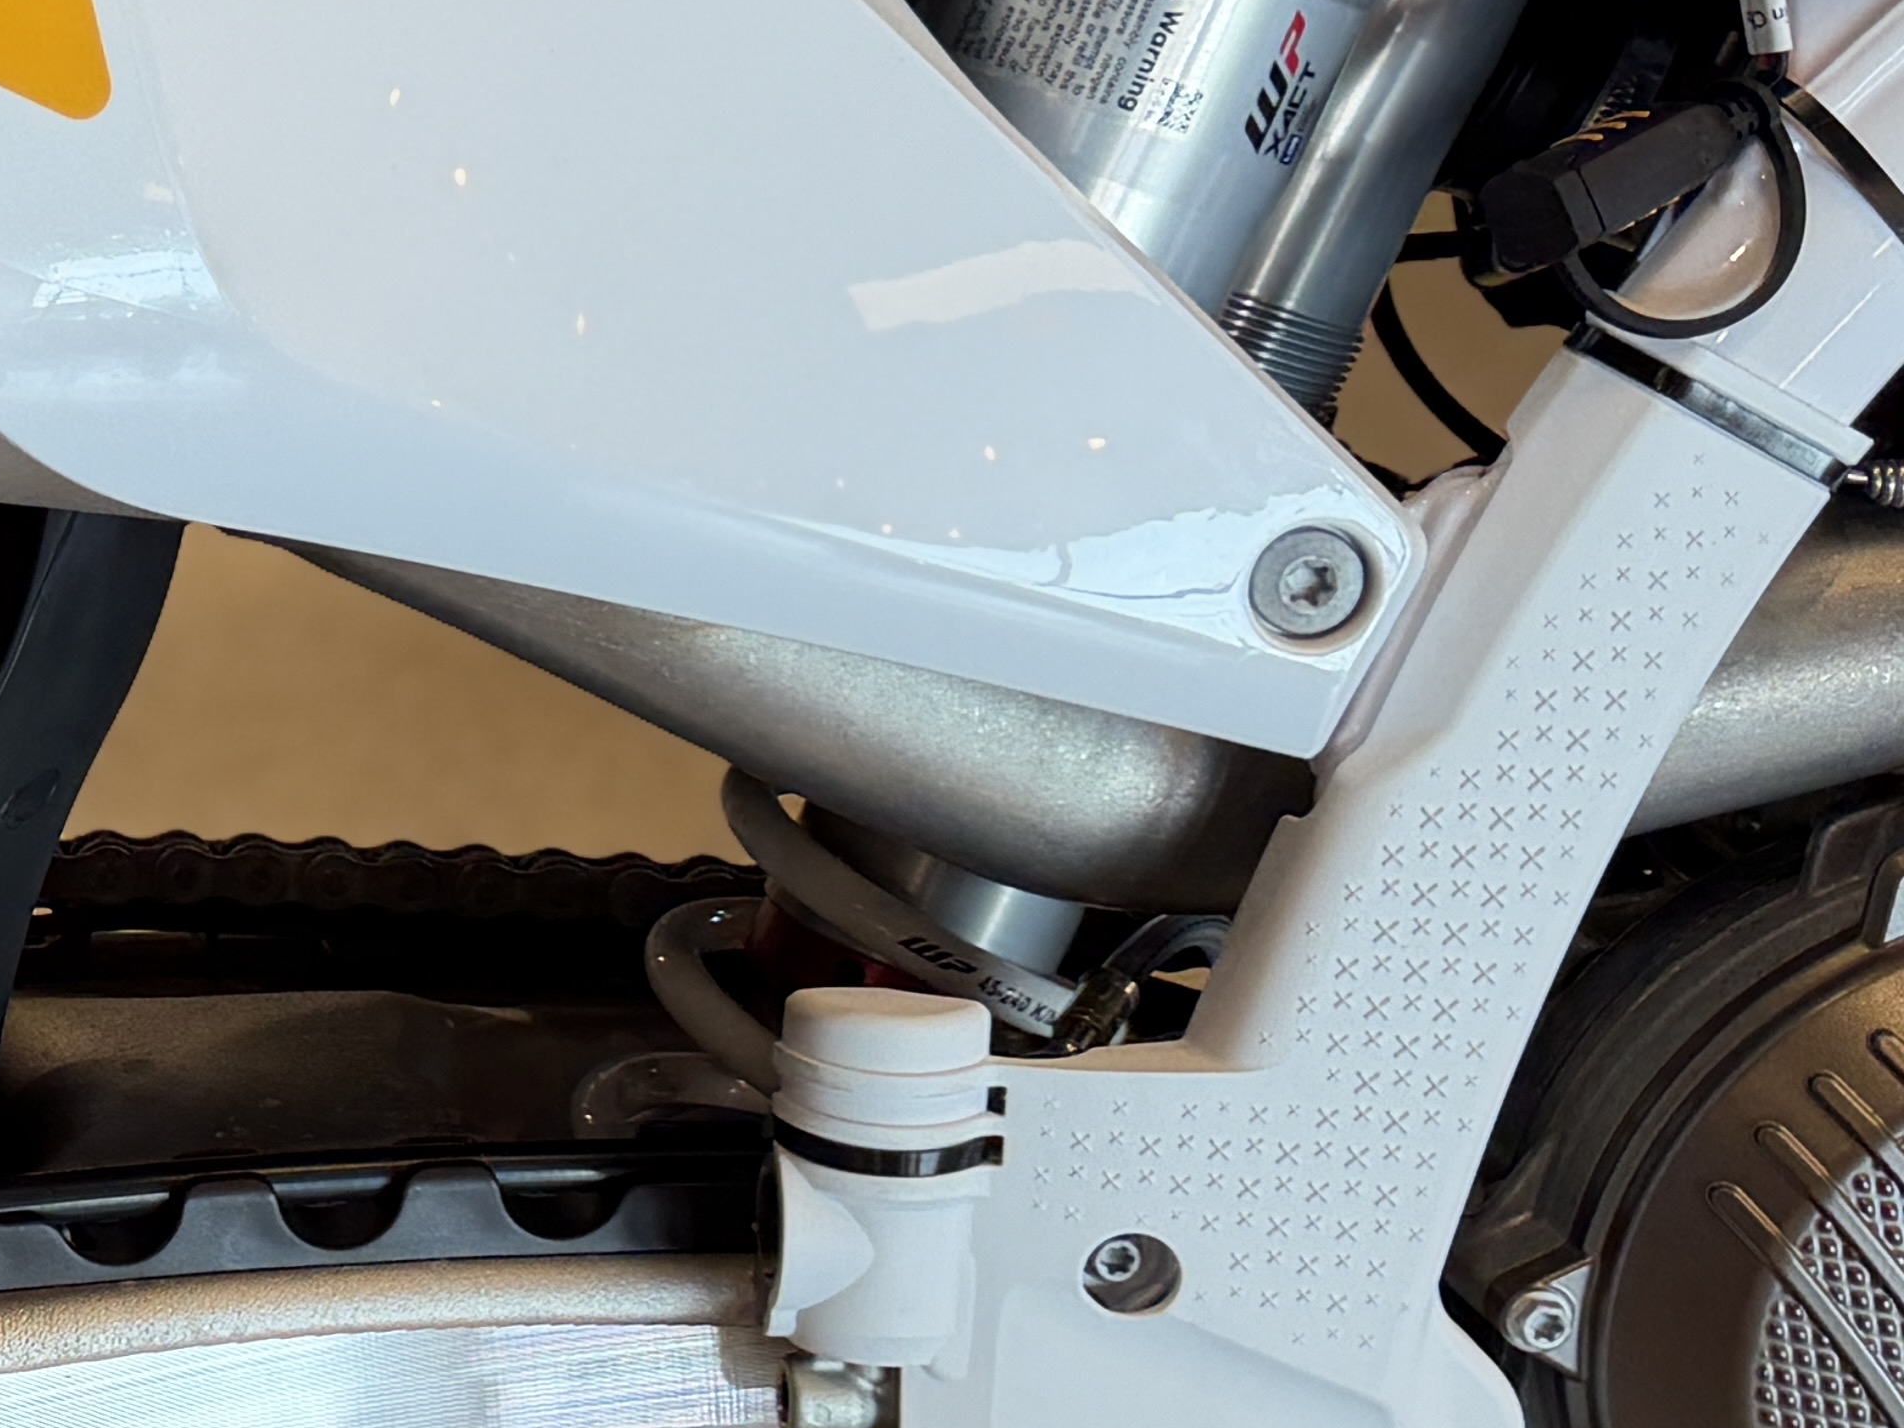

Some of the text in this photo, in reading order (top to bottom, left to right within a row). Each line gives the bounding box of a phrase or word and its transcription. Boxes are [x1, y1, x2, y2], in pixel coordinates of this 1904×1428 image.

[1114, 10, 1184, 113] Warning
[1245, 10, 1307, 154] WP
[1263, 60, 1316, 158] XACT
[897, 936, 978, 974] WP
